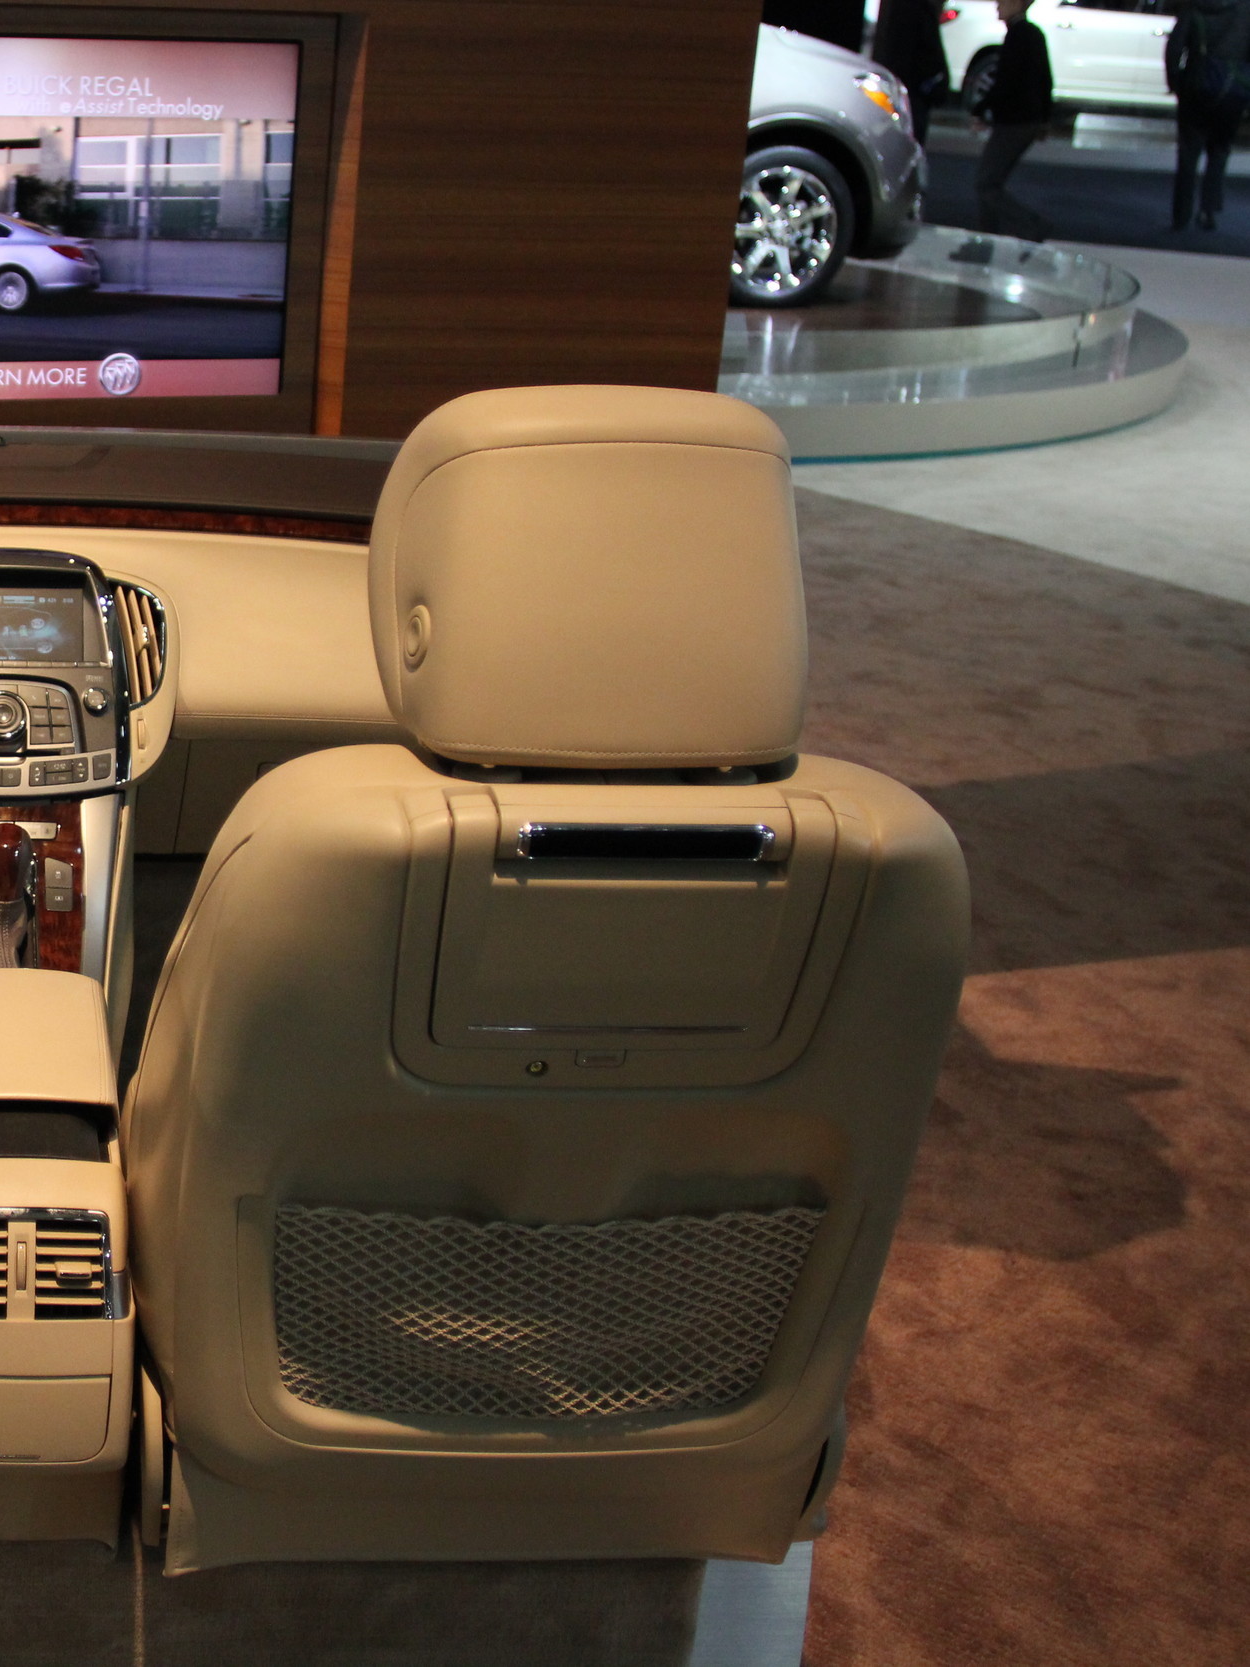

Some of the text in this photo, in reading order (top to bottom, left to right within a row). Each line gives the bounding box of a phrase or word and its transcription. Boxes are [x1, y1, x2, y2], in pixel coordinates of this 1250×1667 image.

[5, 75, 73, 96] BUICK
[79, 76, 154, 97] REGAL
[127, 96, 225, 121] Technology
[26, 367, 87, 387] MORE
